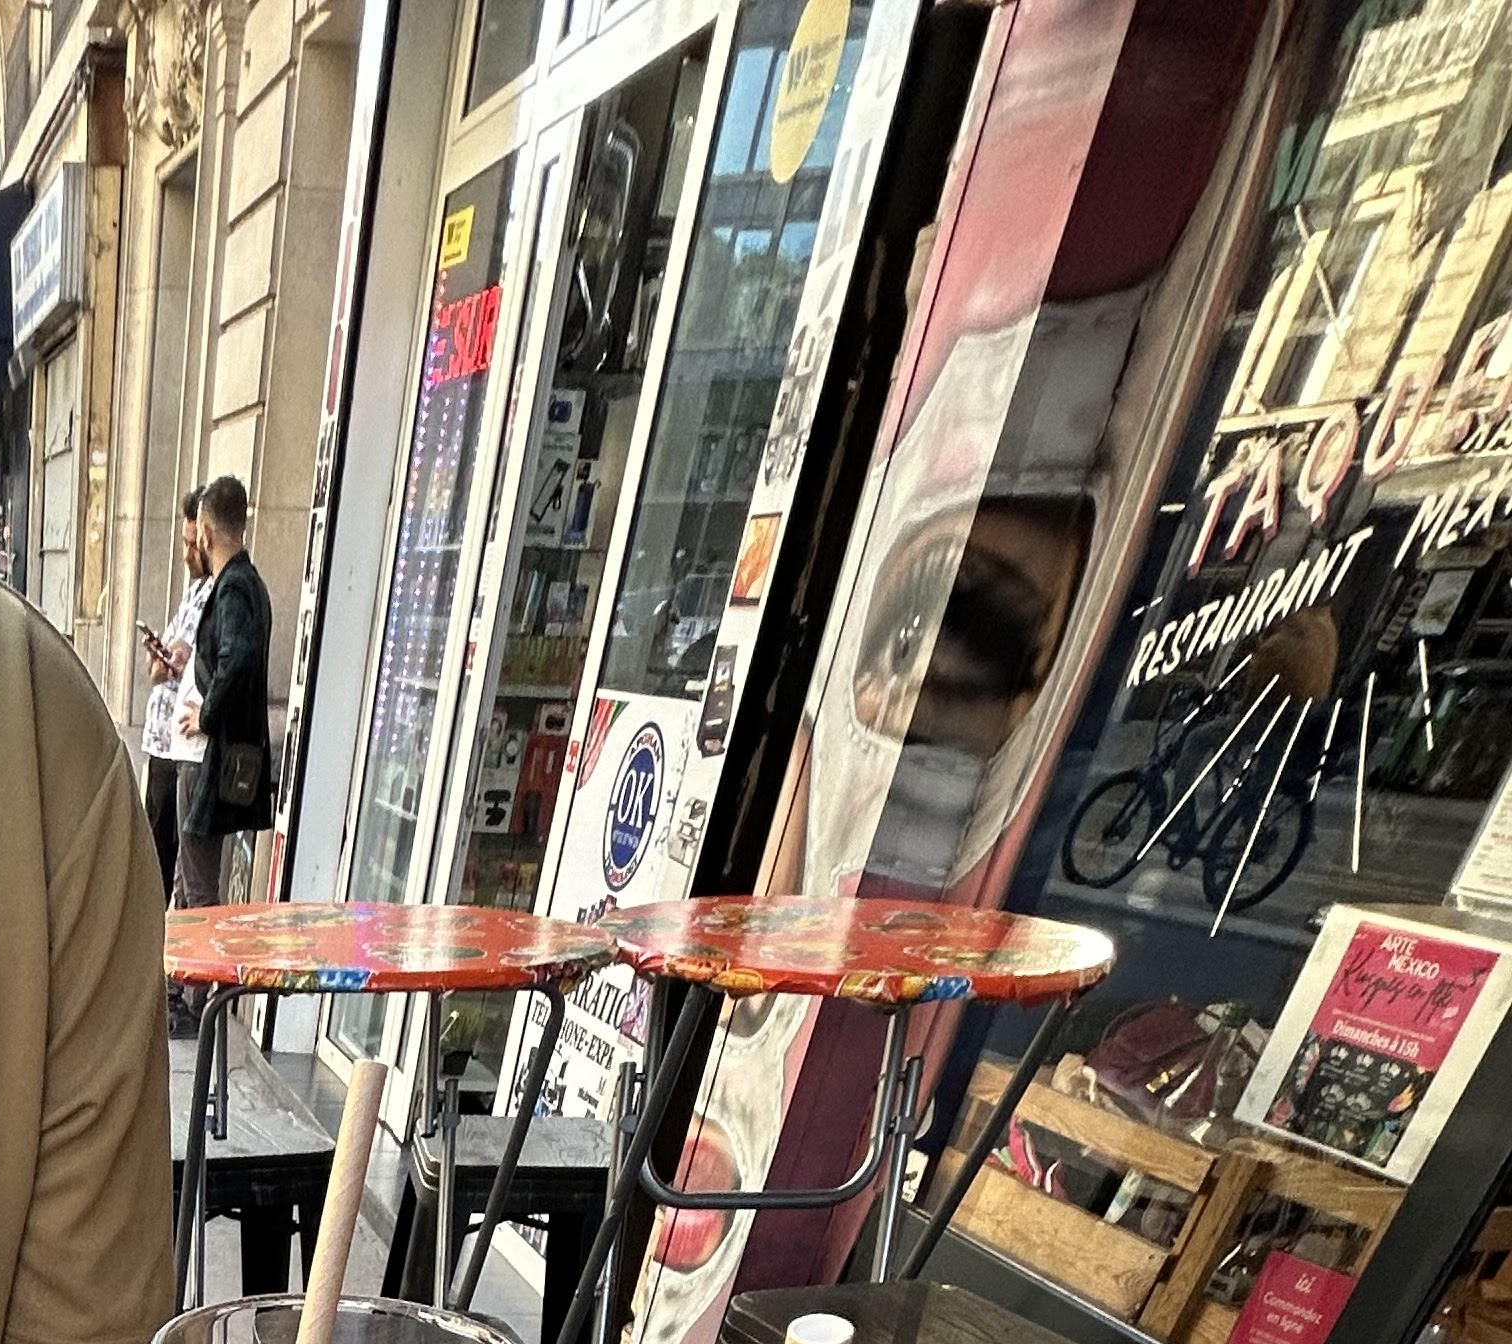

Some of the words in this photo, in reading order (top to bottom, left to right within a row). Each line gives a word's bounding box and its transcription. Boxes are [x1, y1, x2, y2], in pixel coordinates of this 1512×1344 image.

[1187, 312, 1512, 580] TAQUE
[1126, 526, 1374, 690] RESTAURANT
[1394, 458, 1512, 570] MEX
[617, 768, 654, 829] OK
[1380, 932, 1419, 957] ARTE
[1332, 1019, 1390, 1050] Dimanches
[1398, 1038, 1420, 1058] 15h
[1263, 1291, 1323, 1325] Commandez
